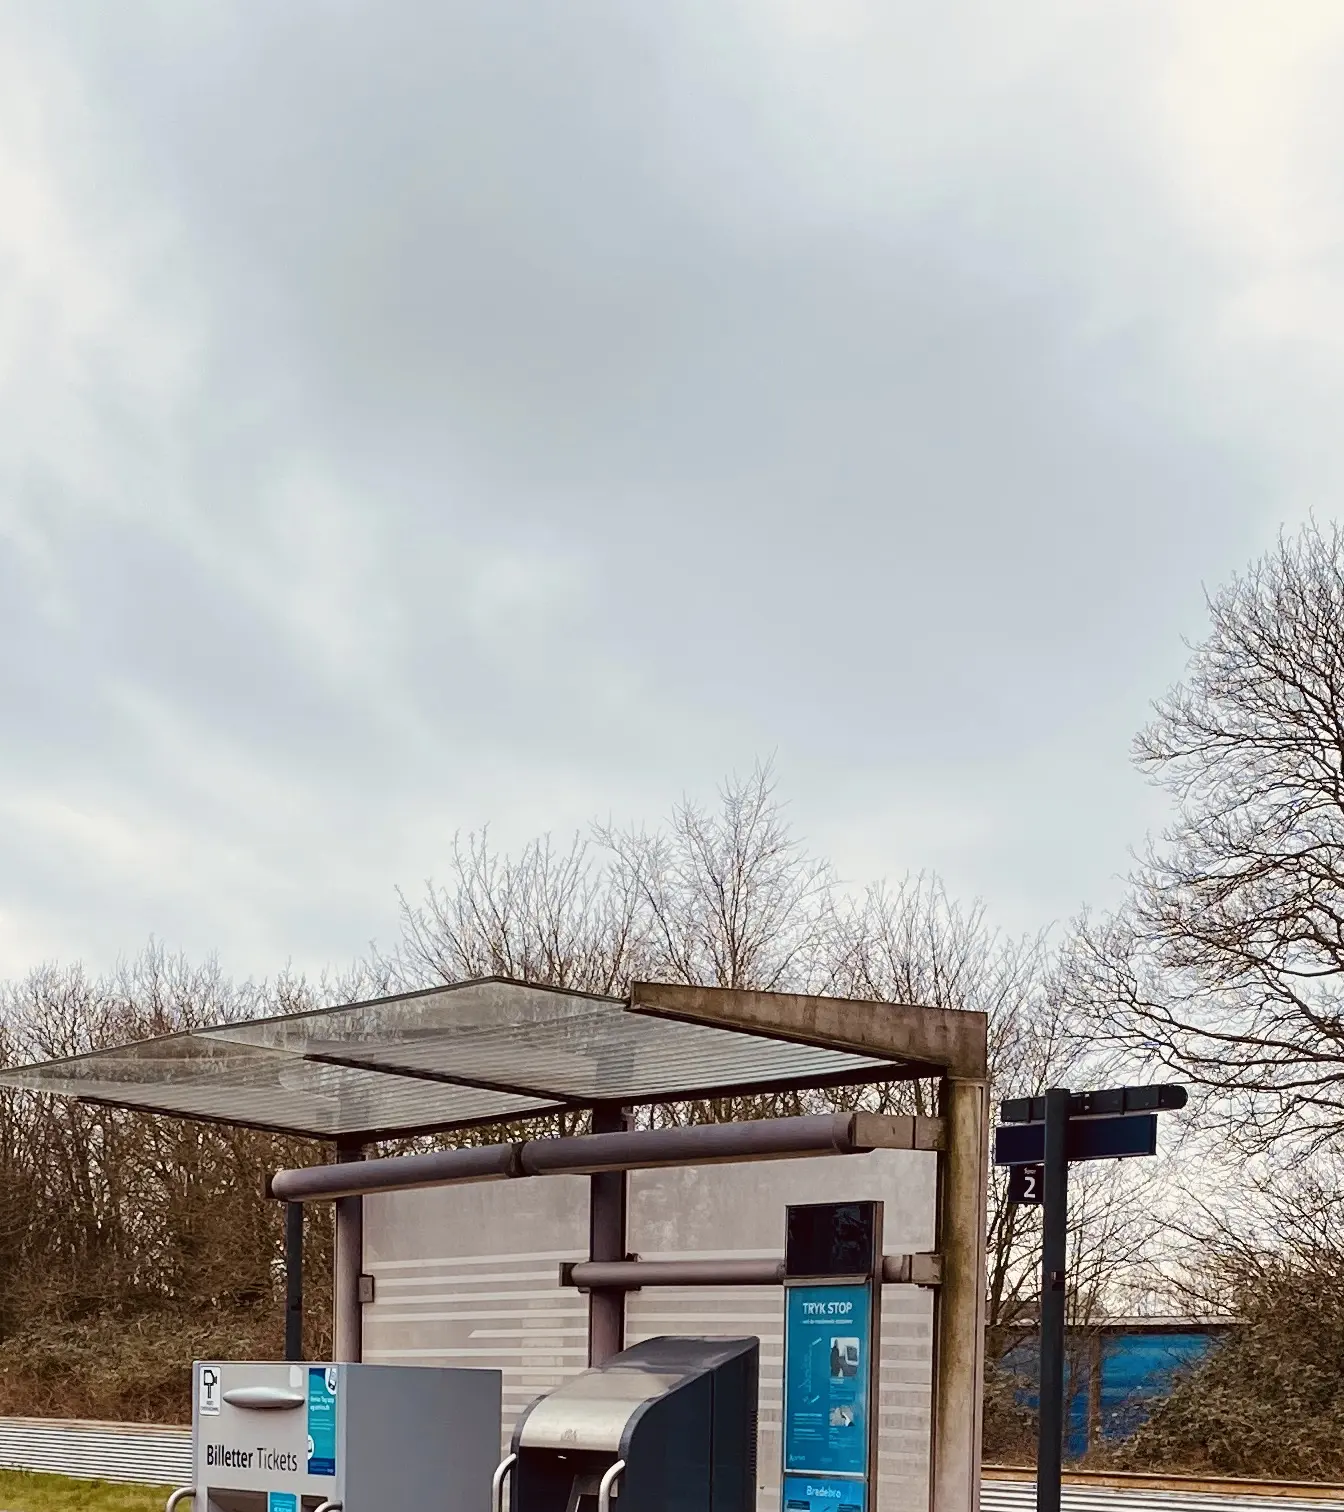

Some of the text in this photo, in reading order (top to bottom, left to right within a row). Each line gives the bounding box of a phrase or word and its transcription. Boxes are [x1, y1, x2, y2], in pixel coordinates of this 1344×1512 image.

[1023, 1176, 1036, 1199] 2
[802, 1301, 853, 1315] TRYK STOP
[206, 1444, 254, 1469] Billetter
[256, 1447, 298, 1472] Tickets
[806, 1485, 842, 1499] Bredebro
